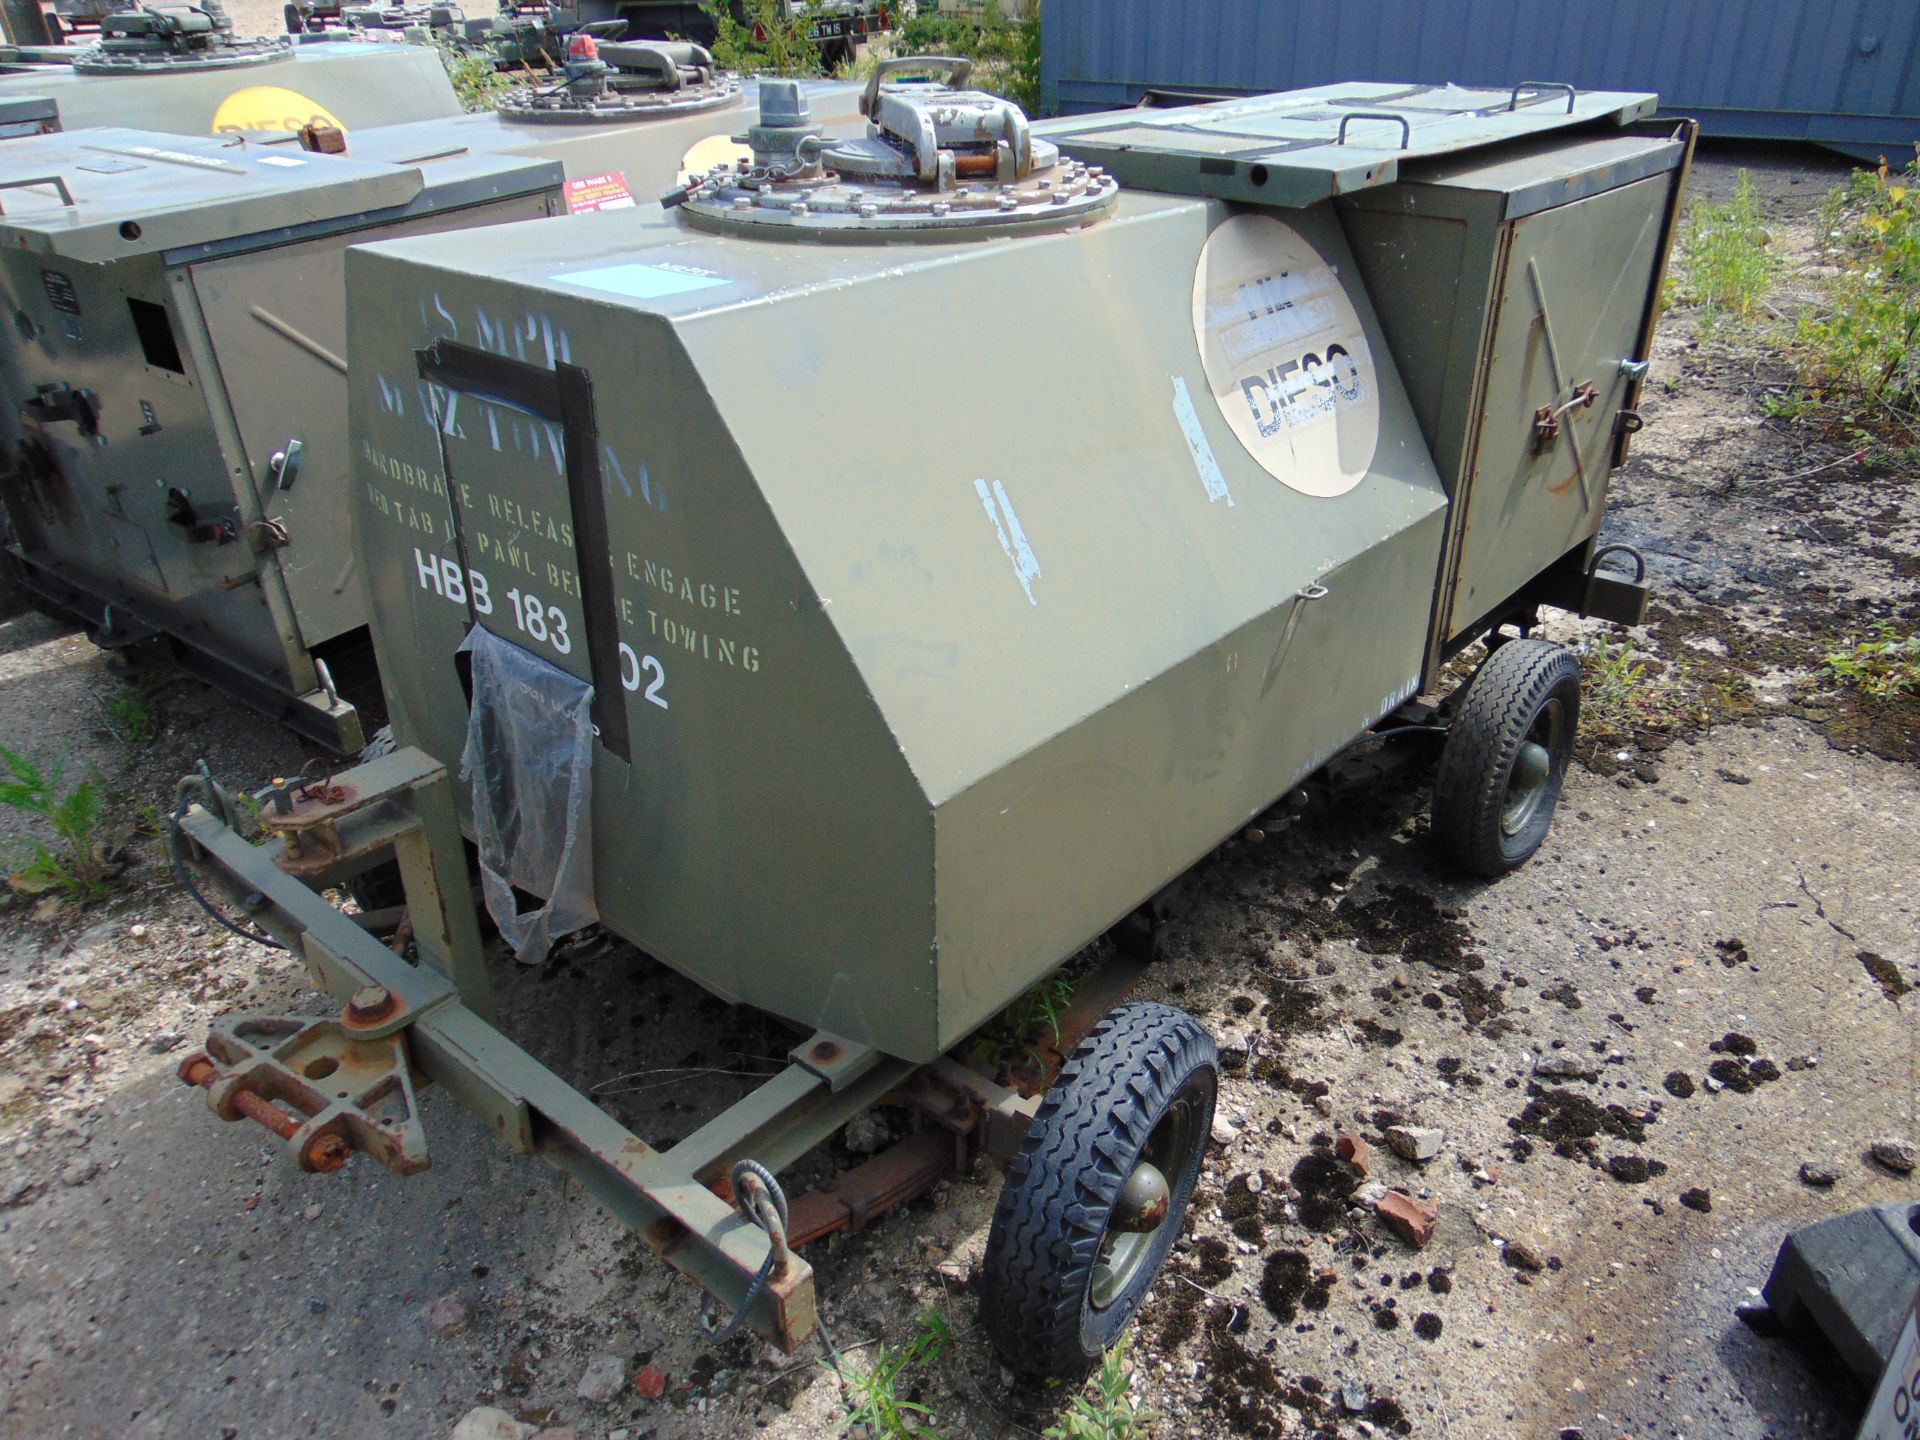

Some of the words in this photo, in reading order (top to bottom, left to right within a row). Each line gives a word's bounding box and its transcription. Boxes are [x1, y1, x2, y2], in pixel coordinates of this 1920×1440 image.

[393, 501, 433, 535] TAB
[476, 531, 537, 577] PAWL
[646, 609, 761, 673] TOWING
[414, 547, 493, 616] HBB
[506, 587, 572, 655] 183
[488, 493, 574, 548] RELEAS
[626, 551, 742, 616] ENGAGE
